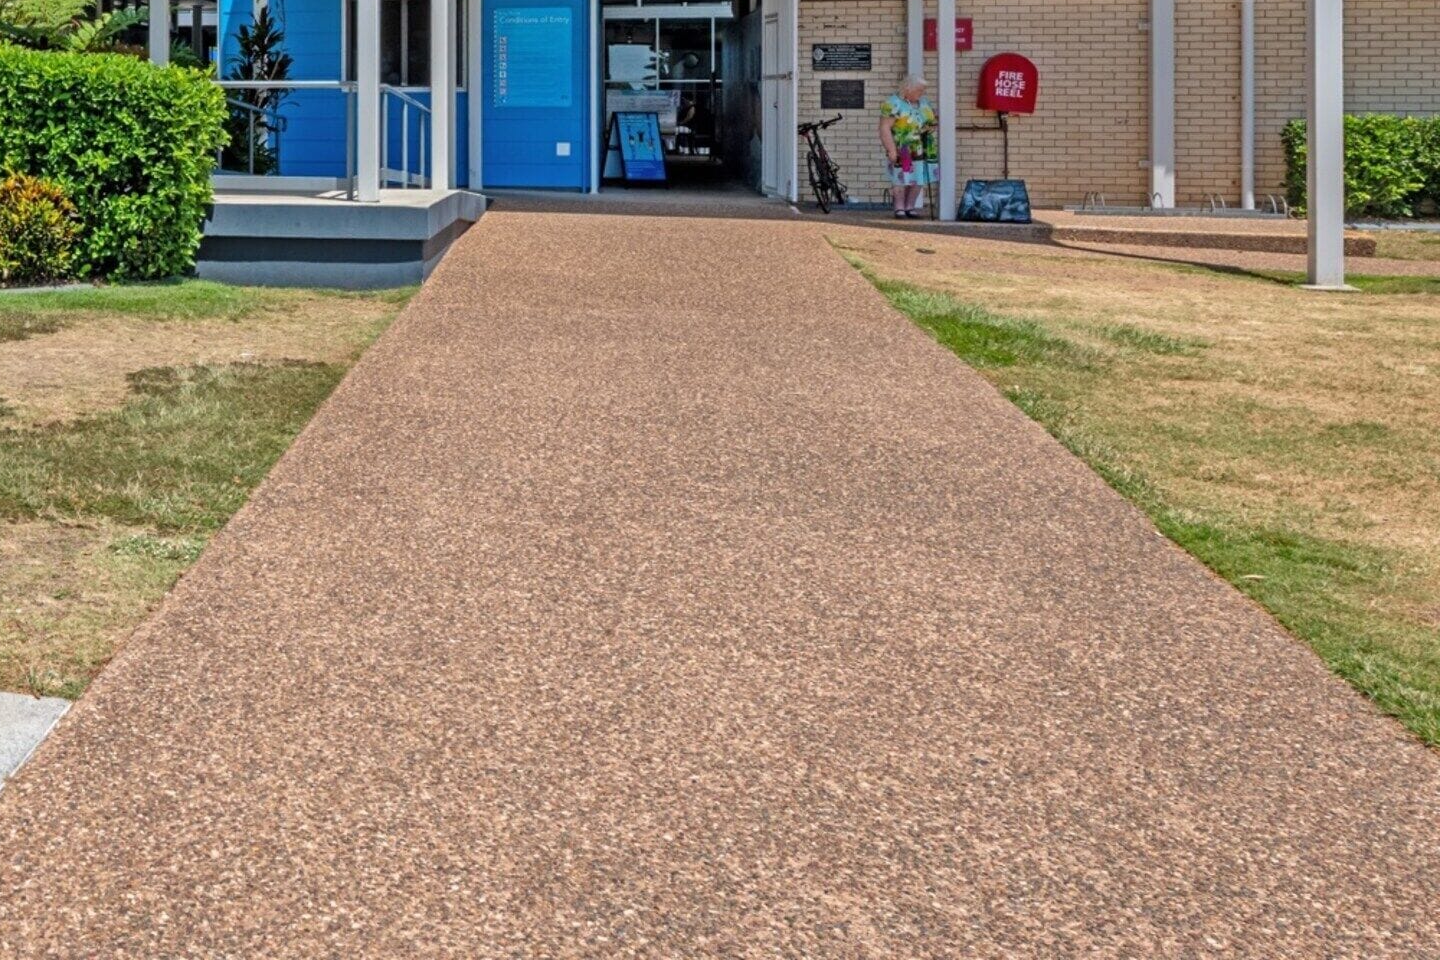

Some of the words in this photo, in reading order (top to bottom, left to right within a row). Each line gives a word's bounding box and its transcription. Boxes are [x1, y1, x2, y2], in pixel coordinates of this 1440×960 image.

[499, 16, 538, 24] Conditions
[550, 16, 570, 25] Entry
[999, 71, 1023, 81] FIRE
[995, 79, 1026, 90] HOSE
[995, 88, 1023, 98] REEL
